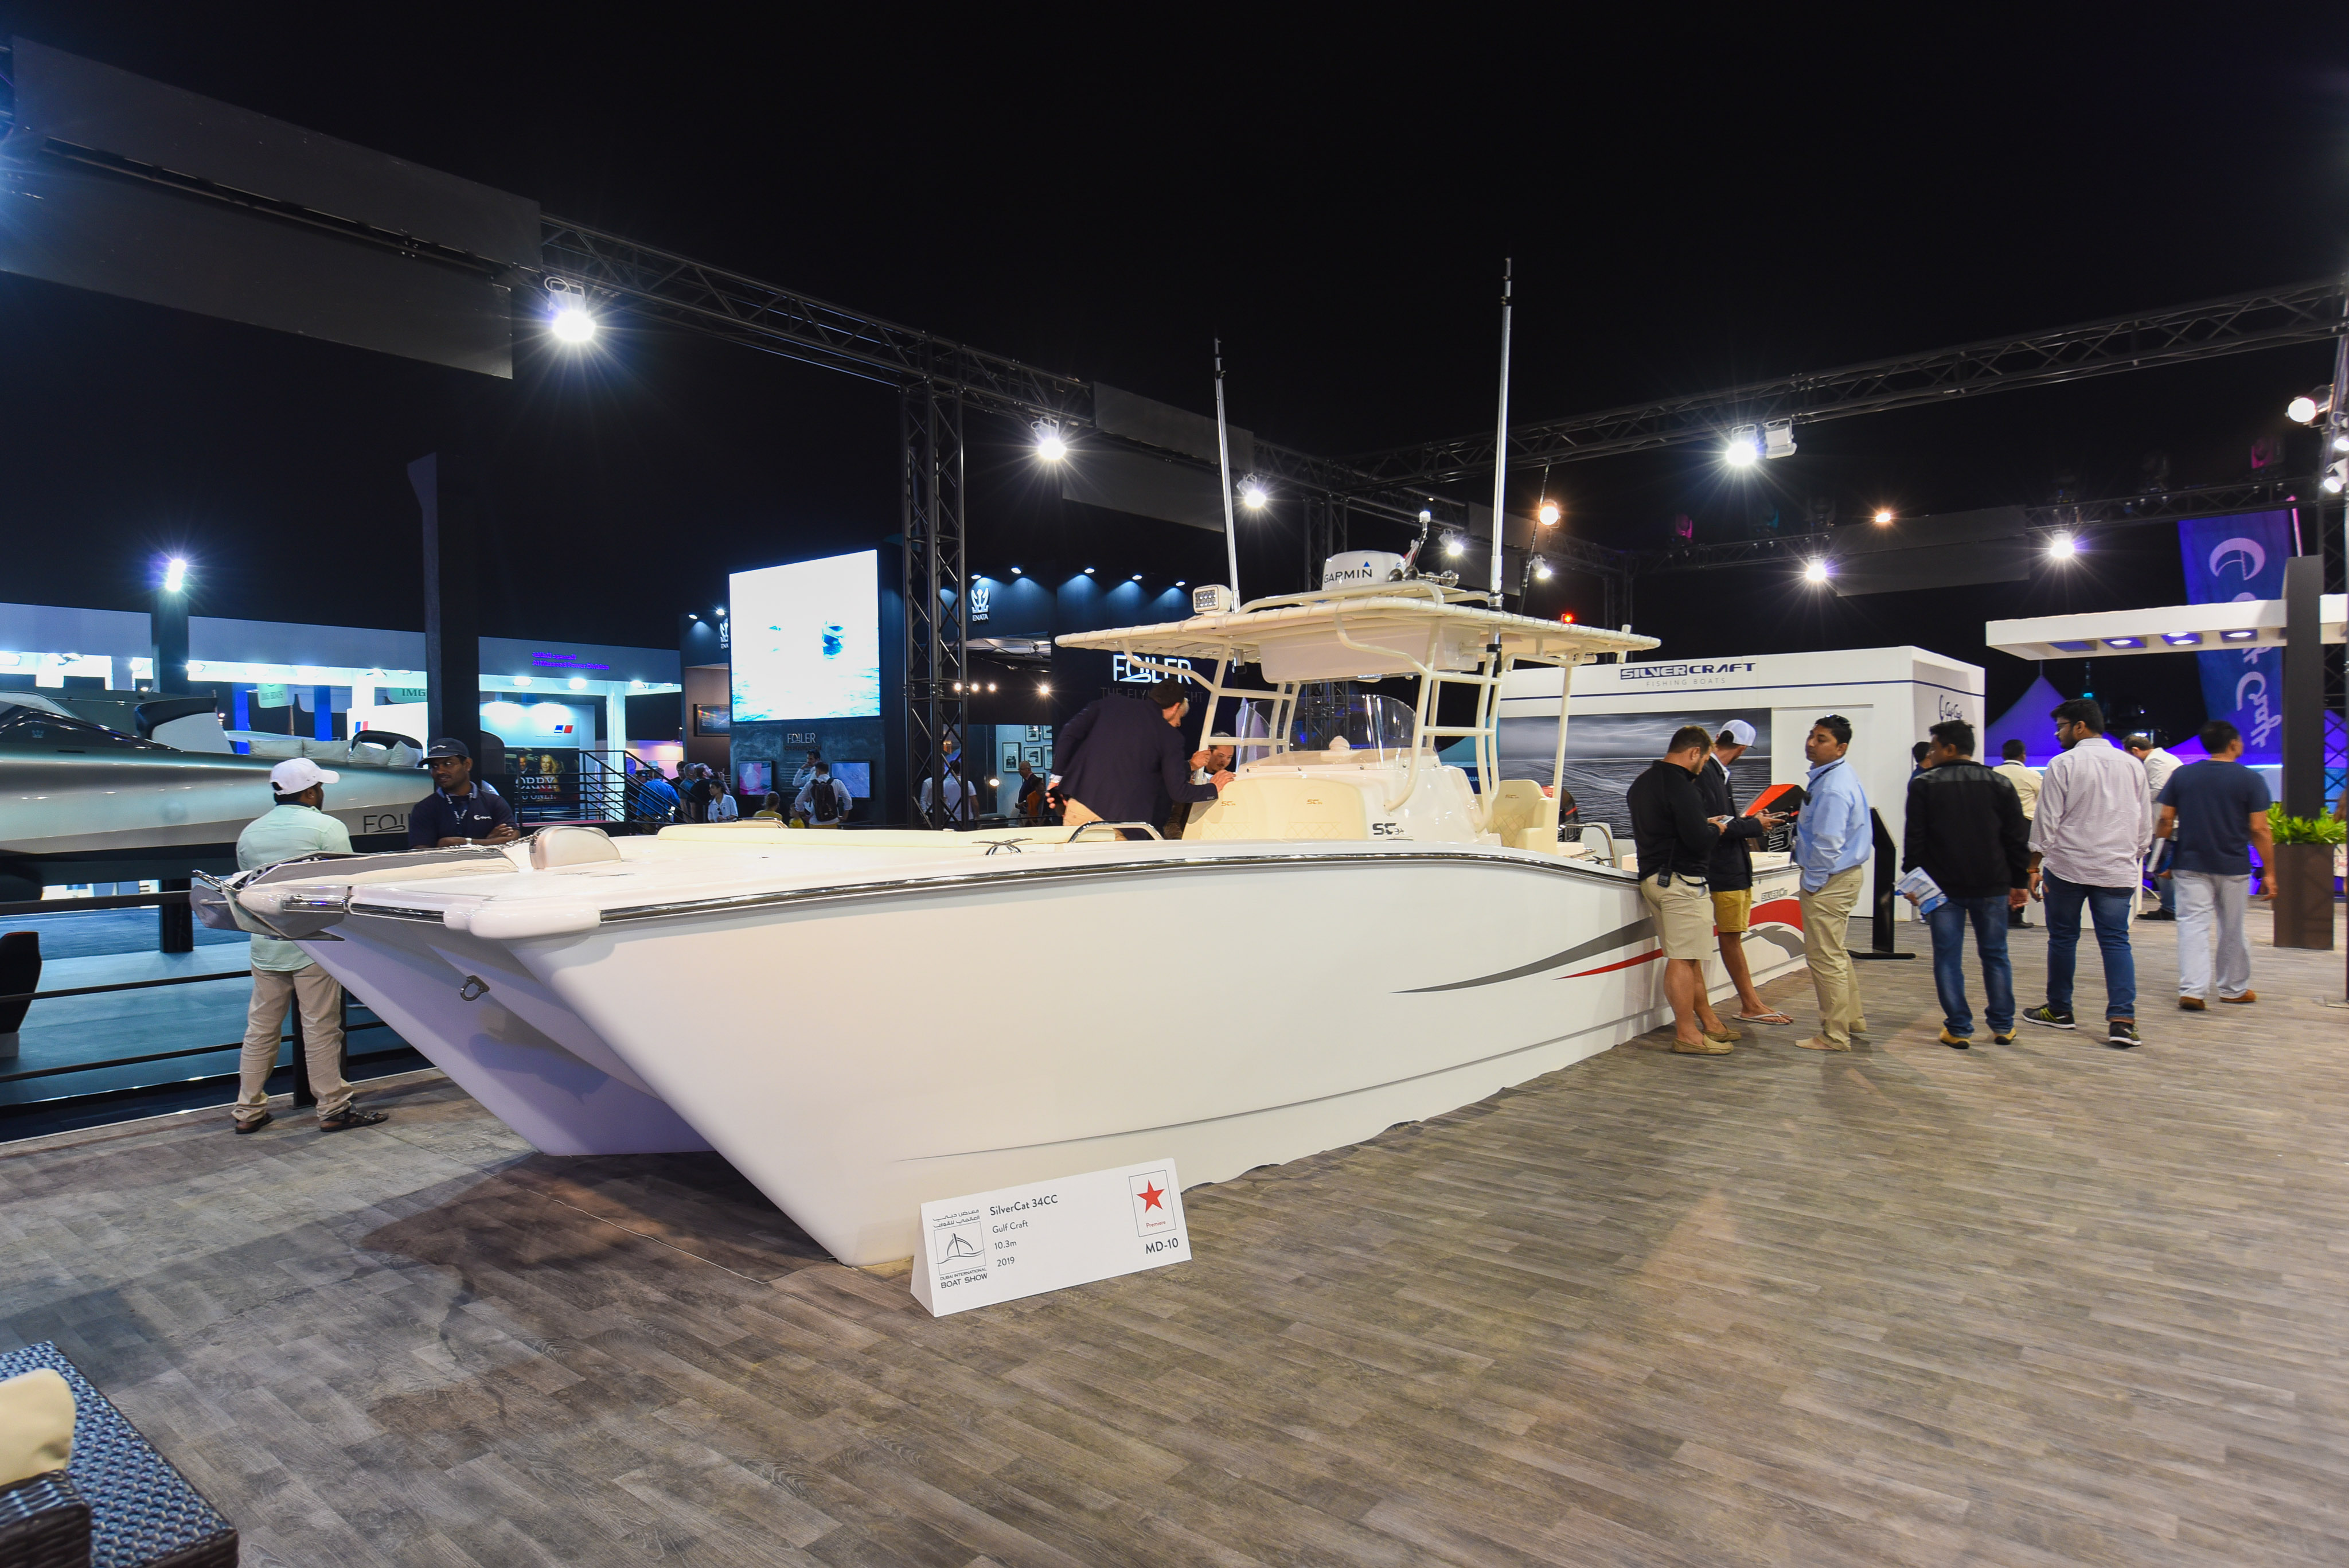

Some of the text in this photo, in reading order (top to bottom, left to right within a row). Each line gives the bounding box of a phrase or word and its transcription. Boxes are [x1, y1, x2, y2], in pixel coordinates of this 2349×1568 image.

[1324, 568, 1372, 583] GARMIN
[972, 614, 989, 622] ENATA
[1646, 679, 1688, 687] FISHING
[402, 688, 426, 697] IMG
[787, 732, 817, 744] FOILER
[363, 813, 411, 833] FOI
[990, 1194, 1058, 1216] SilverCat 34CC
[932, 1209, 980, 1222] معرض دبي
[955, 1215, 980, 1226] العالمي
[992, 1219, 1029, 1234] Gulf Craft
[994, 1240, 1017, 1250] 10.3m
[1146, 1238, 1179, 1254] MD-10
[997, 1257, 1015, 1267] 2019
[954, 1267, 987, 1278] INTERNATIONAL
[941, 1273, 988, 1289] BOAT SHOW
